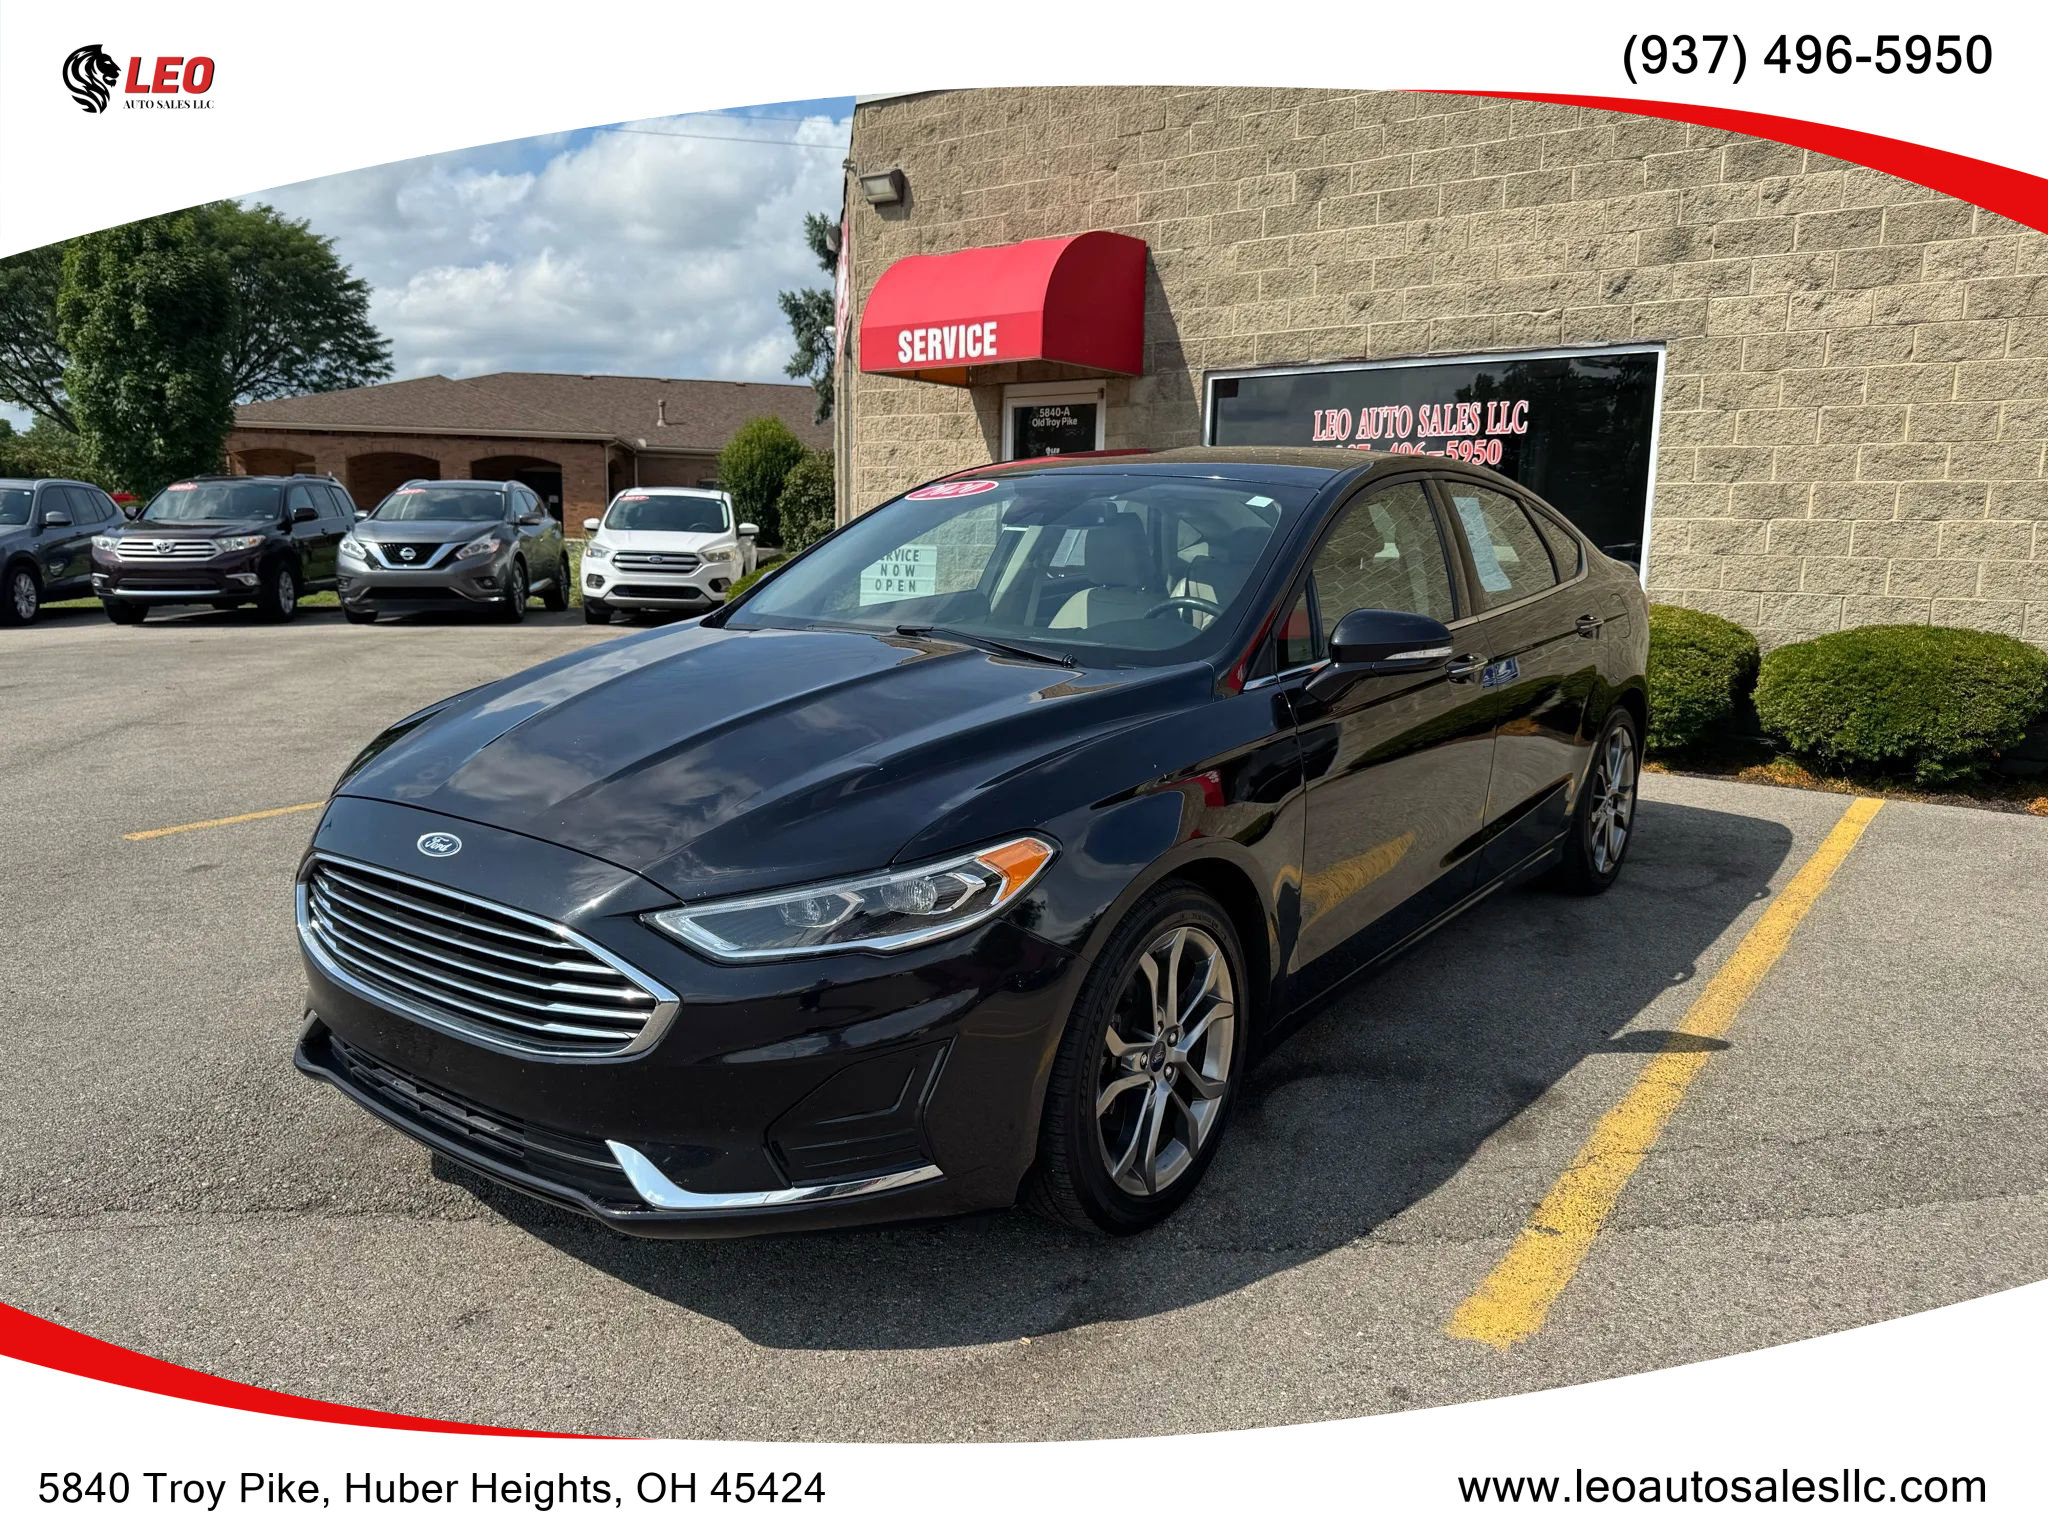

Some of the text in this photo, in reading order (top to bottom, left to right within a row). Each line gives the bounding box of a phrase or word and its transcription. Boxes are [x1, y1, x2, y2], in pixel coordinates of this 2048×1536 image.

[897, 321, 998, 364] SERVICE
[1040, 406, 1071, 418] 5840-A
[1031, 416, 1078, 428] Old Troy Pike
[1312, 400, 1529, 441] LEO AUTO SALES LLC
[880, 563, 915, 577] NOW
[875, 579, 916, 592] OPEN
